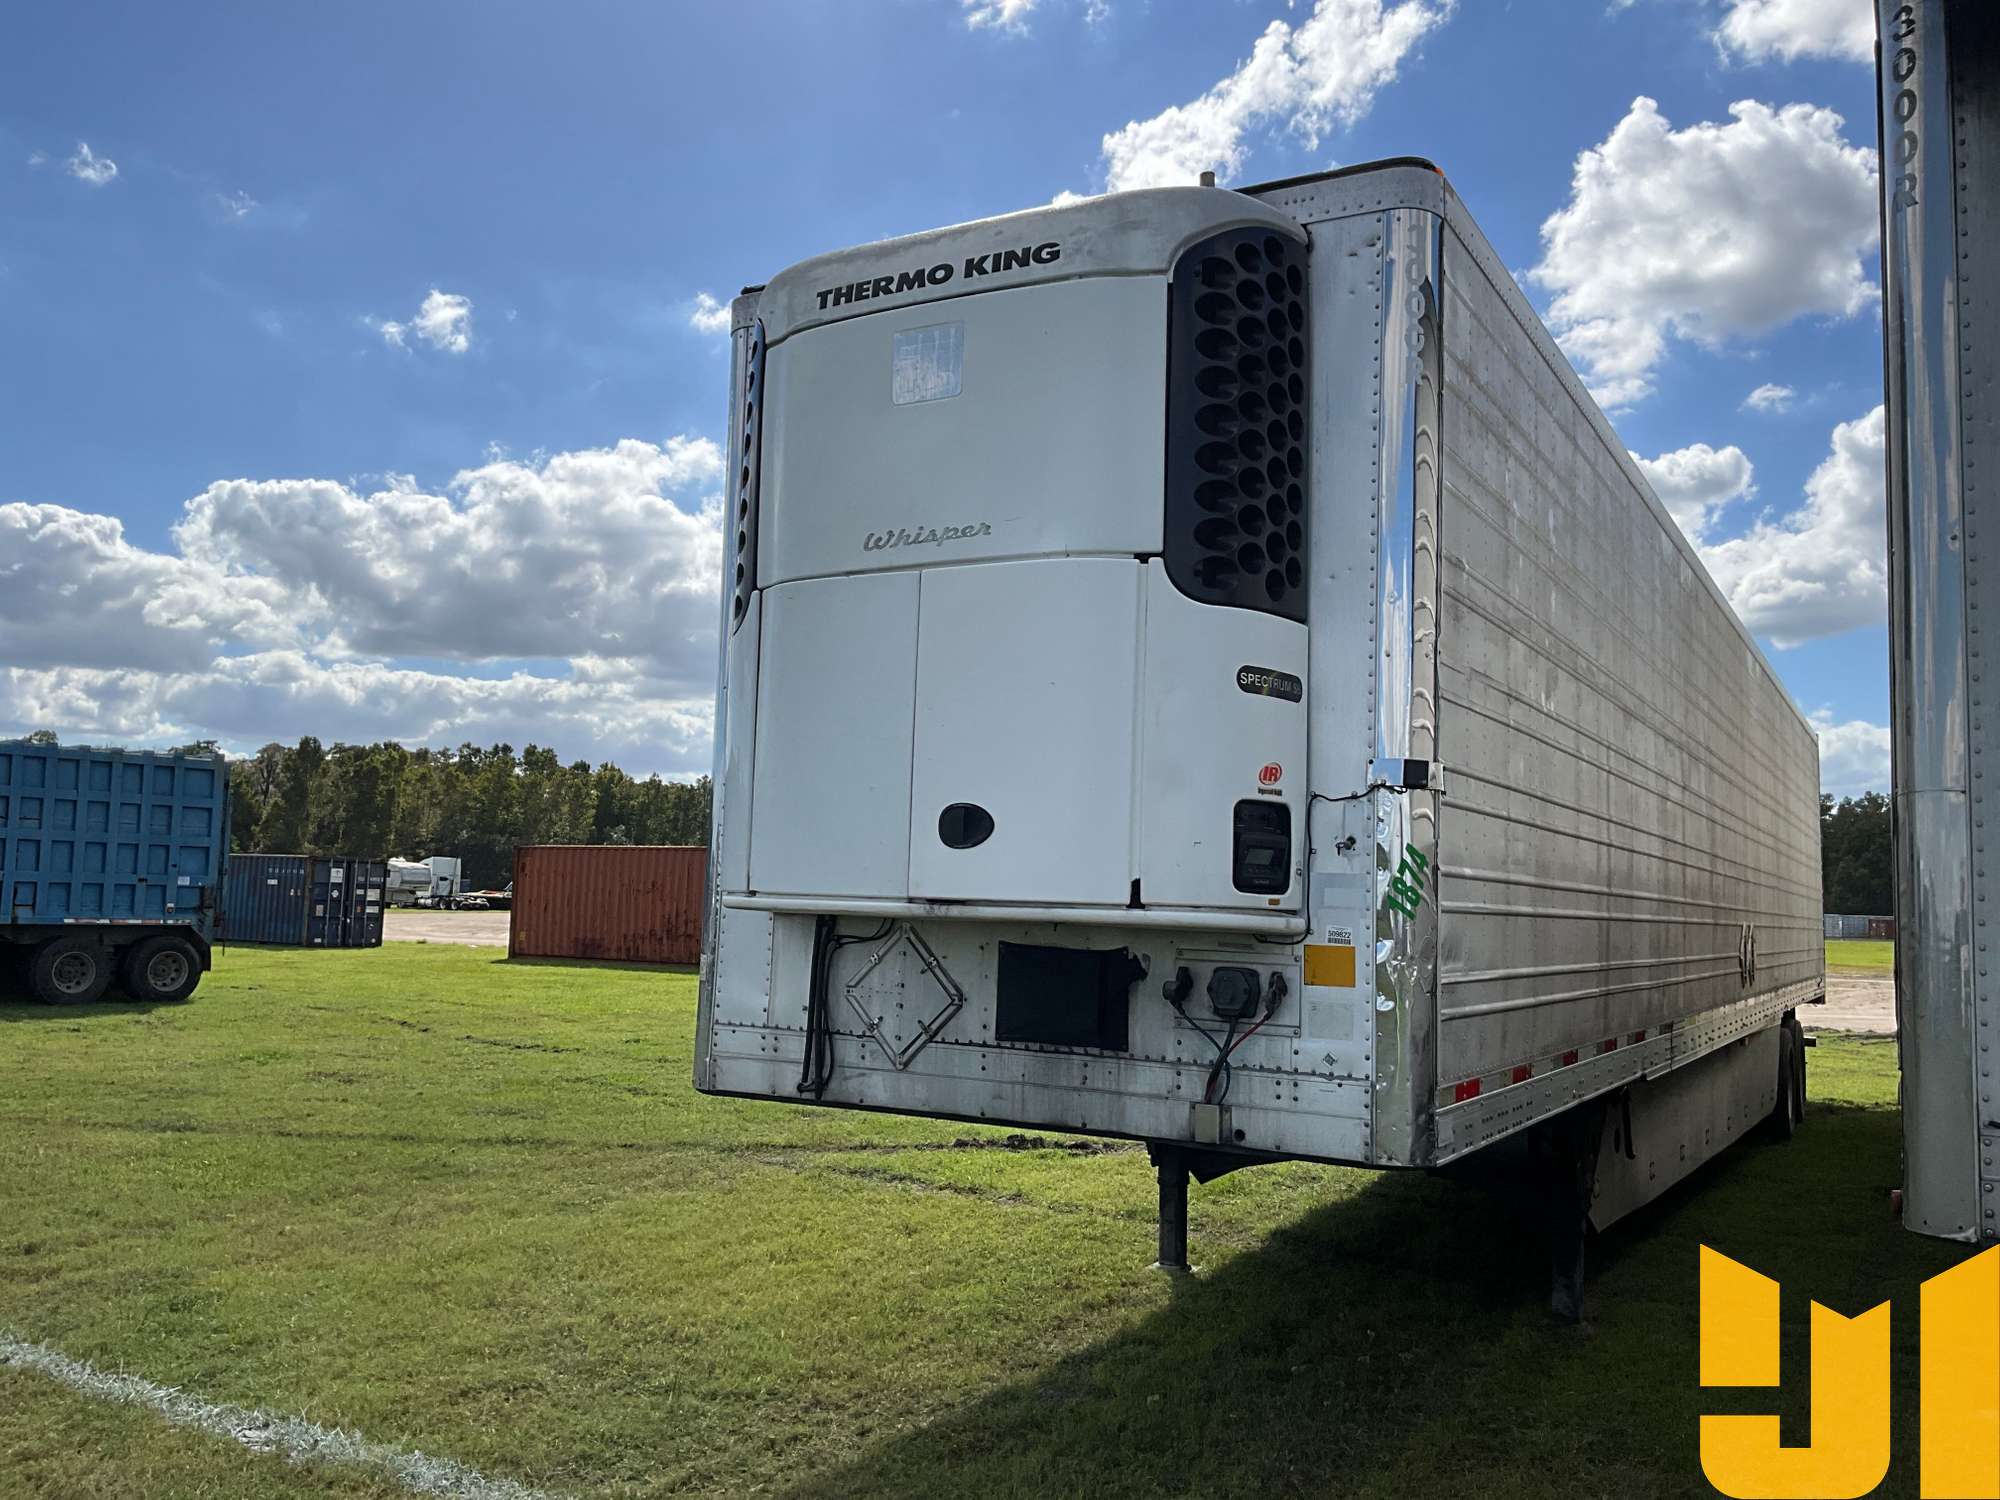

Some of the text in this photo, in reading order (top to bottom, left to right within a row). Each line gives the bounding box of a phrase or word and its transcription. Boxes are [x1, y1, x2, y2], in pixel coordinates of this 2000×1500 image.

[816, 242, 1061, 310] THERMO KING
[863, 522, 992, 552] Whisper
[1240, 672, 1292, 692] SPECTRUM
[1388, 843, 1428, 920] 1874
